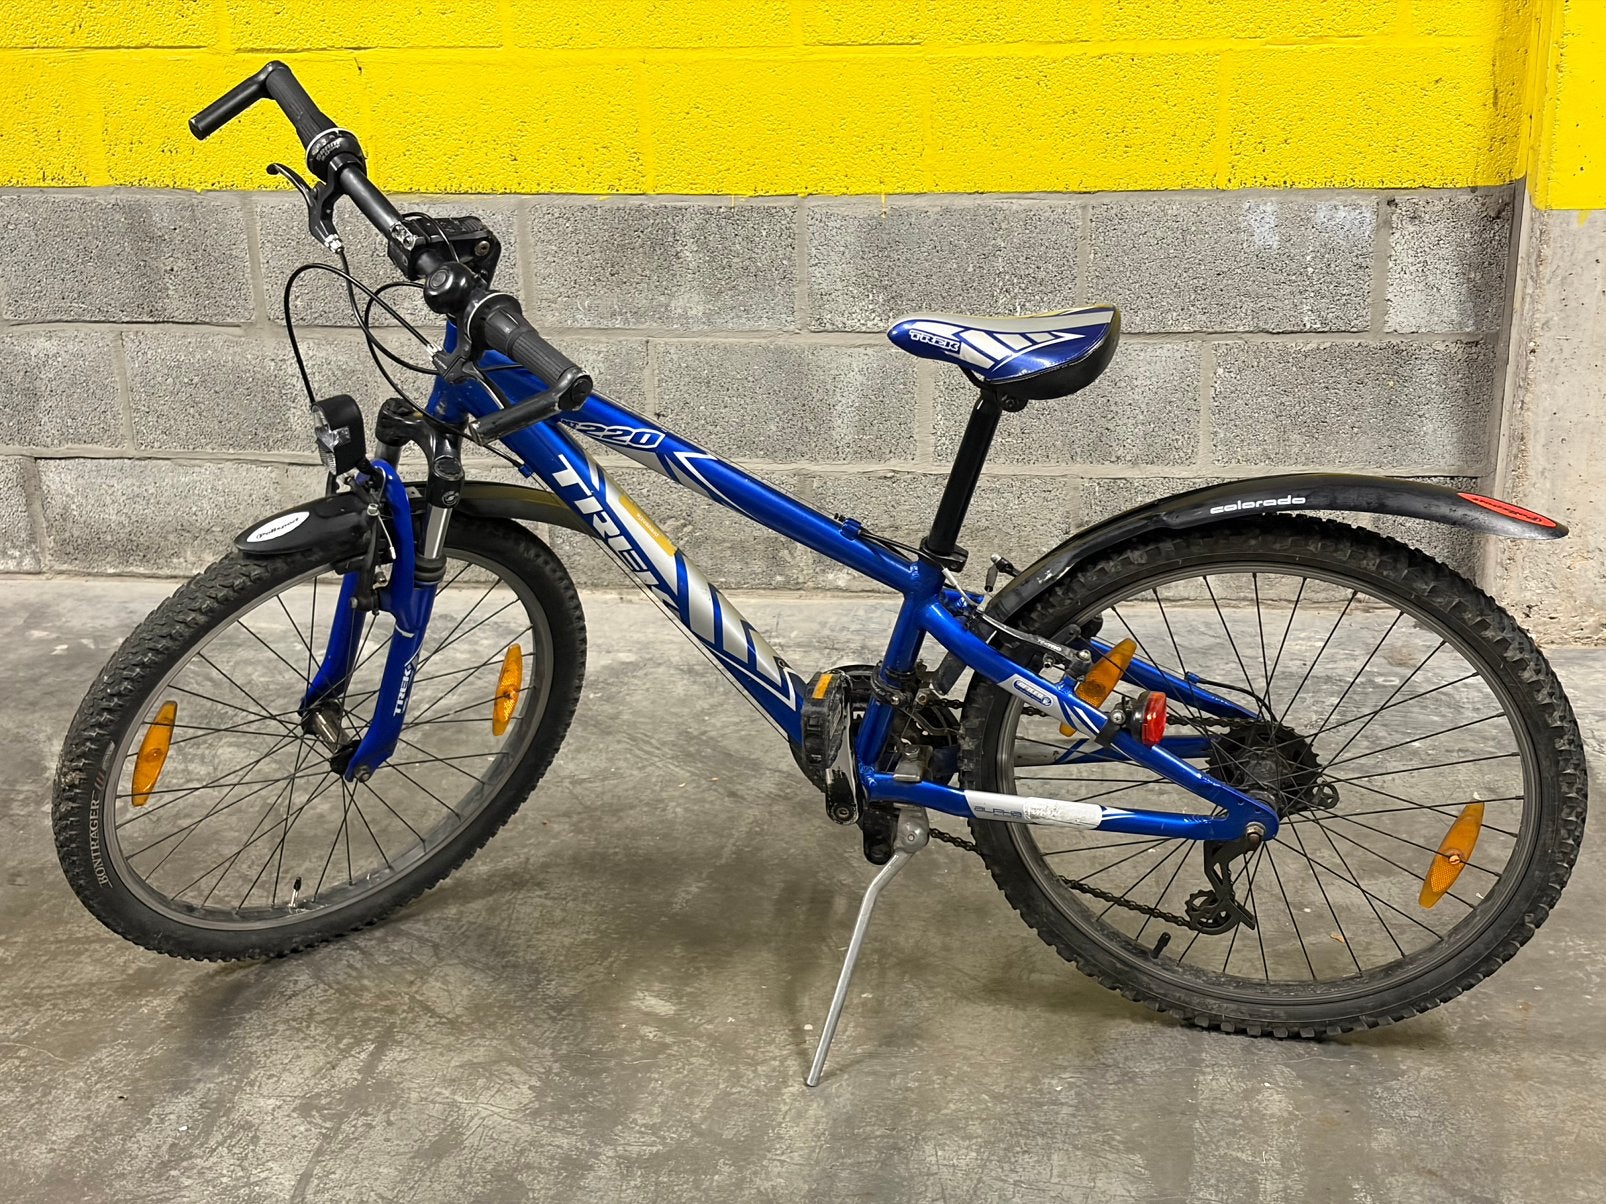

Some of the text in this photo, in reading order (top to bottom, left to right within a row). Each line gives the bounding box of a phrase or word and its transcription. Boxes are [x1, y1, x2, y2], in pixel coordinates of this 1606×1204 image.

[909, 329, 960, 352] TREK
[574, 422, 665, 449] 220
[1210, 495, 1306, 514] colorado
[393, 668, 412, 717] TREK
[89, 790, 113, 888] BONTRAGER
